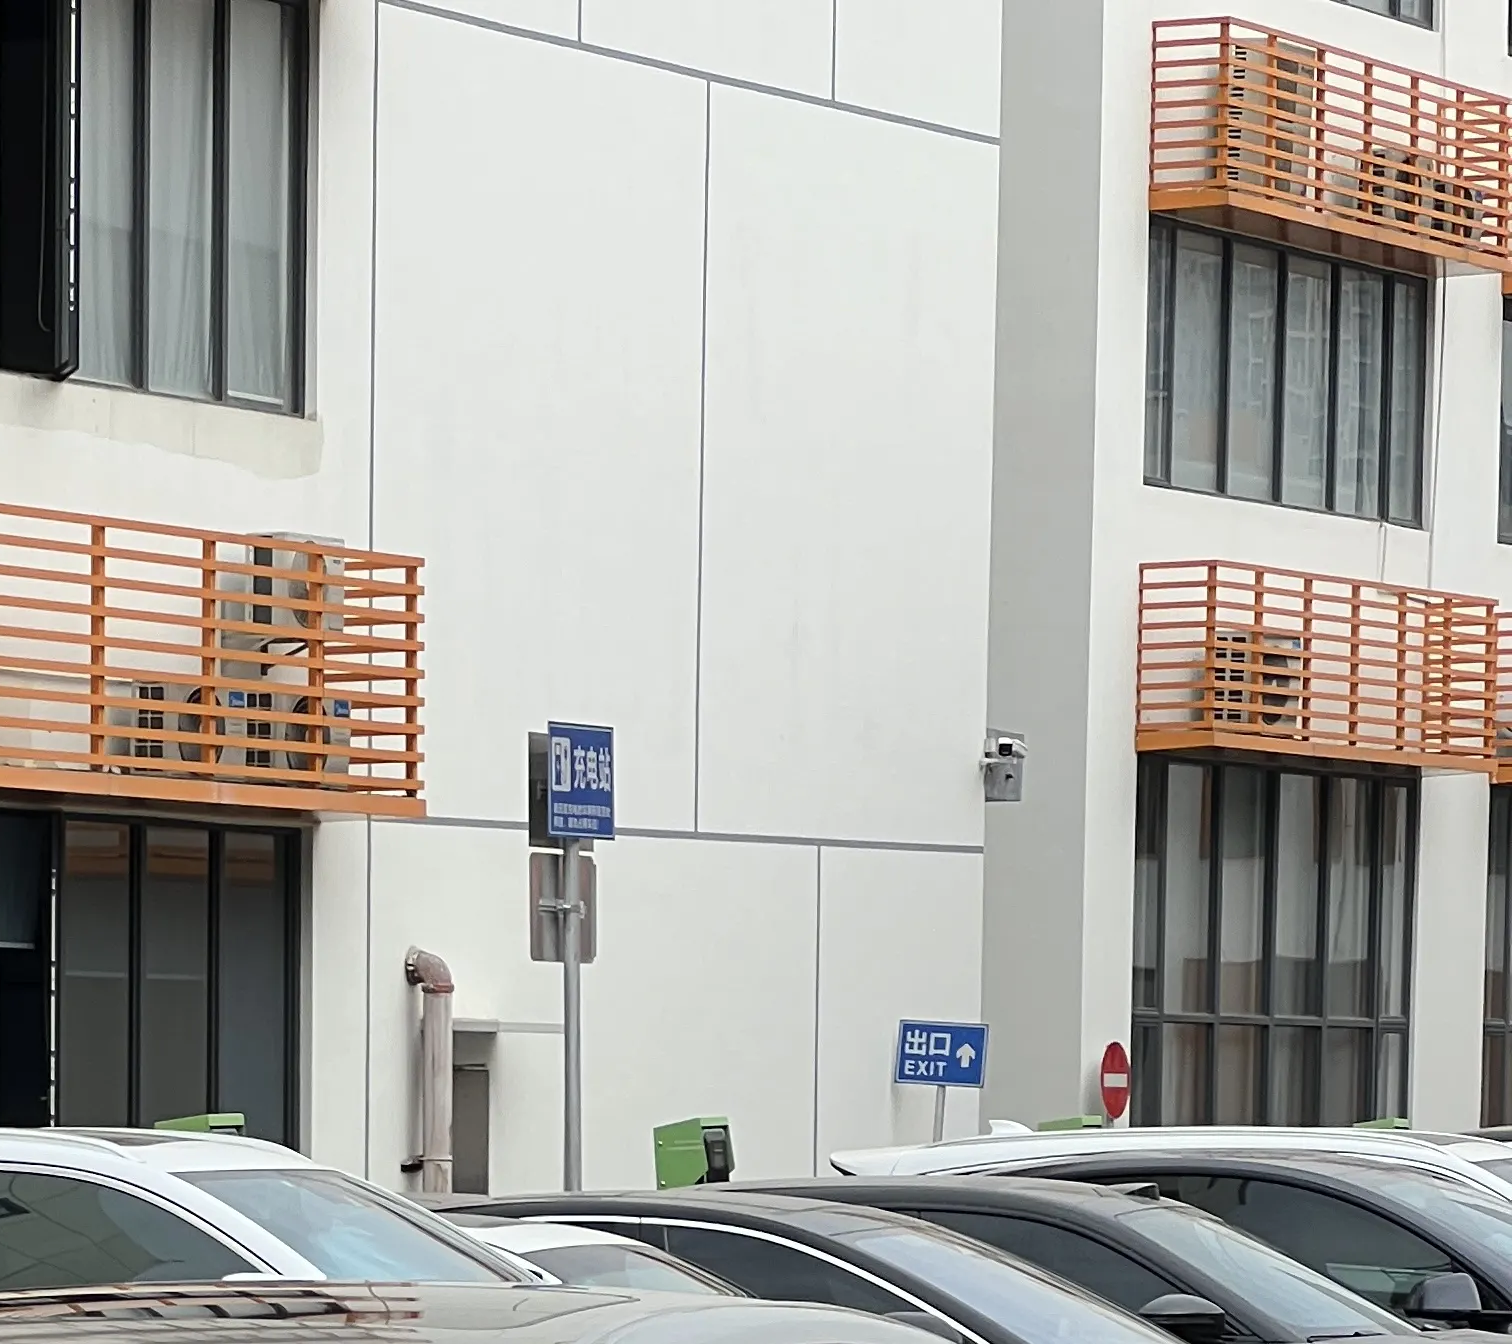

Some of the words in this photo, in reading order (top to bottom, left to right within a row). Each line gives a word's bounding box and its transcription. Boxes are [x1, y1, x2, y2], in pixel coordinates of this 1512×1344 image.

[573, 745, 611, 792] 充电站
[905, 1029, 952, 1056] 出口
[904, 1060, 948, 1077] EXIT
